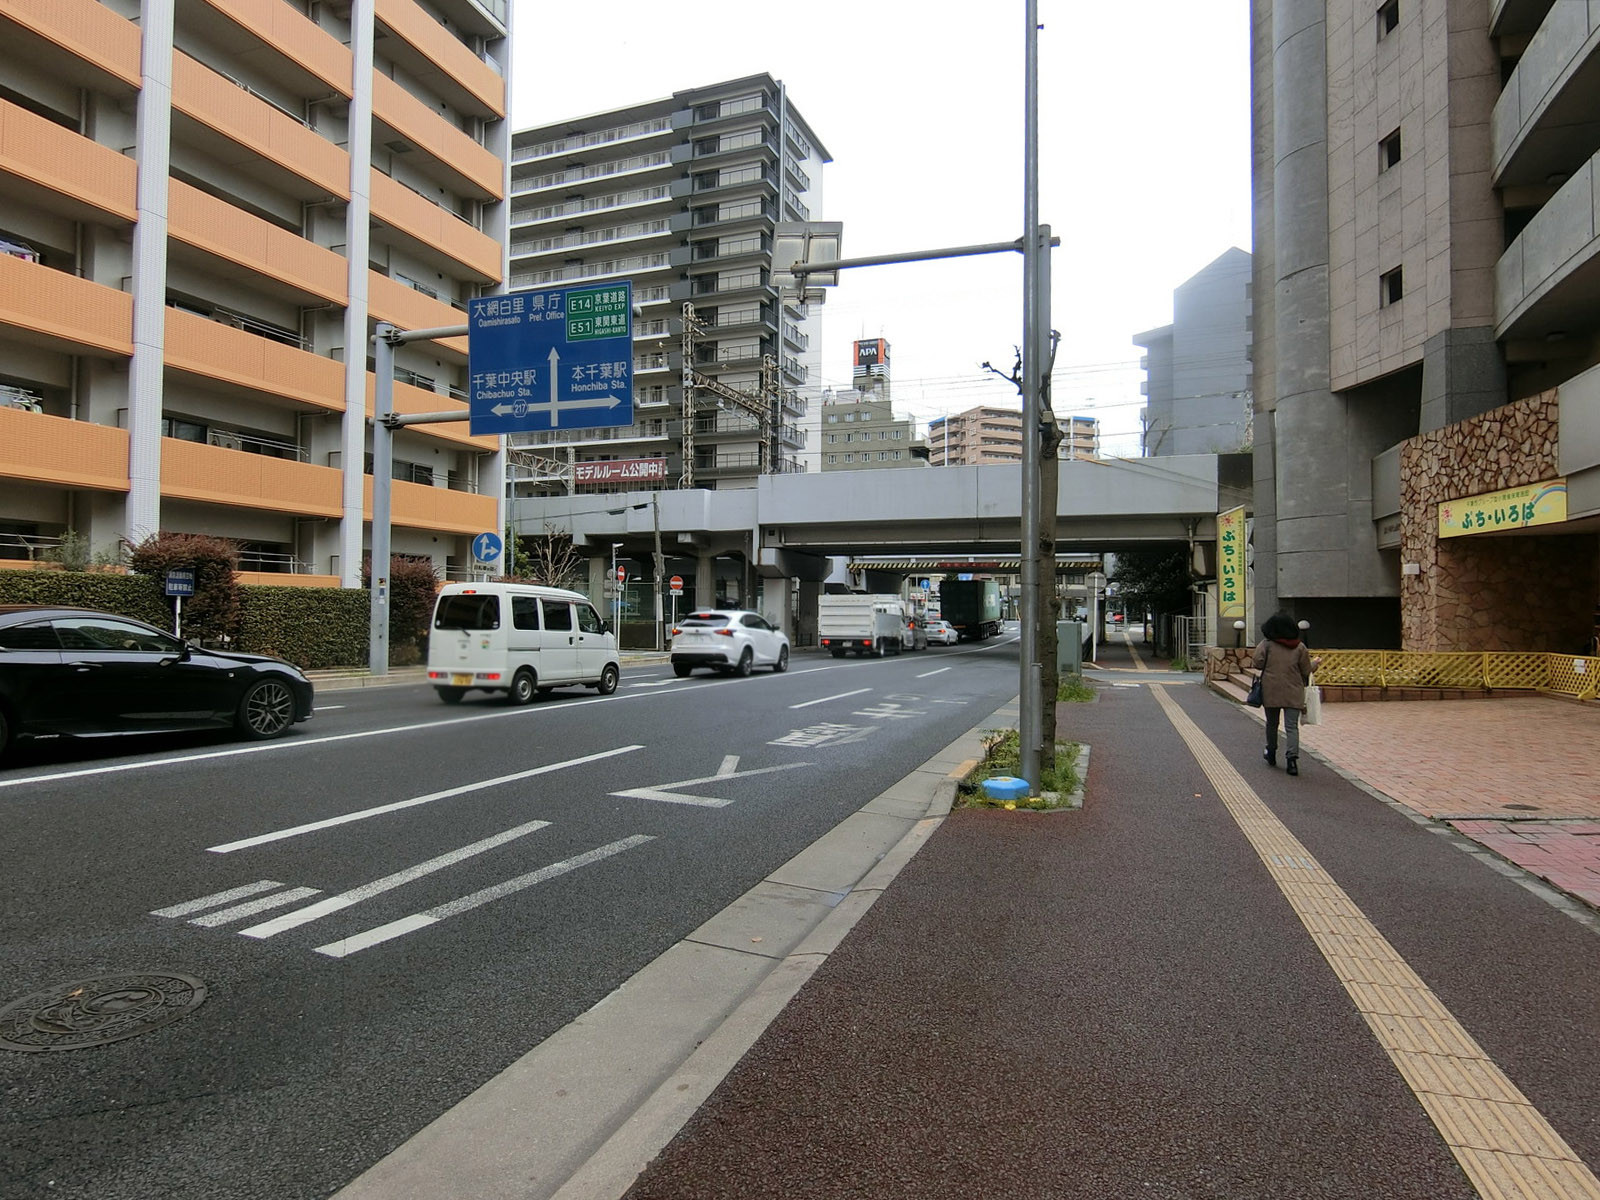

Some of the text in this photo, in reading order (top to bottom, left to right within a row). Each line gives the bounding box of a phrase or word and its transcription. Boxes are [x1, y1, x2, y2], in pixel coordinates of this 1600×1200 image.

[474, 292, 561, 318] 大網白里 県庁
[571, 298, 591, 311] E14
[614, 302, 626, 311] EXP
[571, 321, 590, 333] E51
[859, 348, 877, 356] APA
[571, 361, 628, 382] 本千葉駅
[472, 369, 537, 390] 千葉中央駅
[571, 379, 627, 393] Honchiba Sta.
[476, 387, 533, 400] Chibachuo Sta.
[514, 403, 526, 413] 217
[576, 461, 658, 480] モデルルーム公開中
